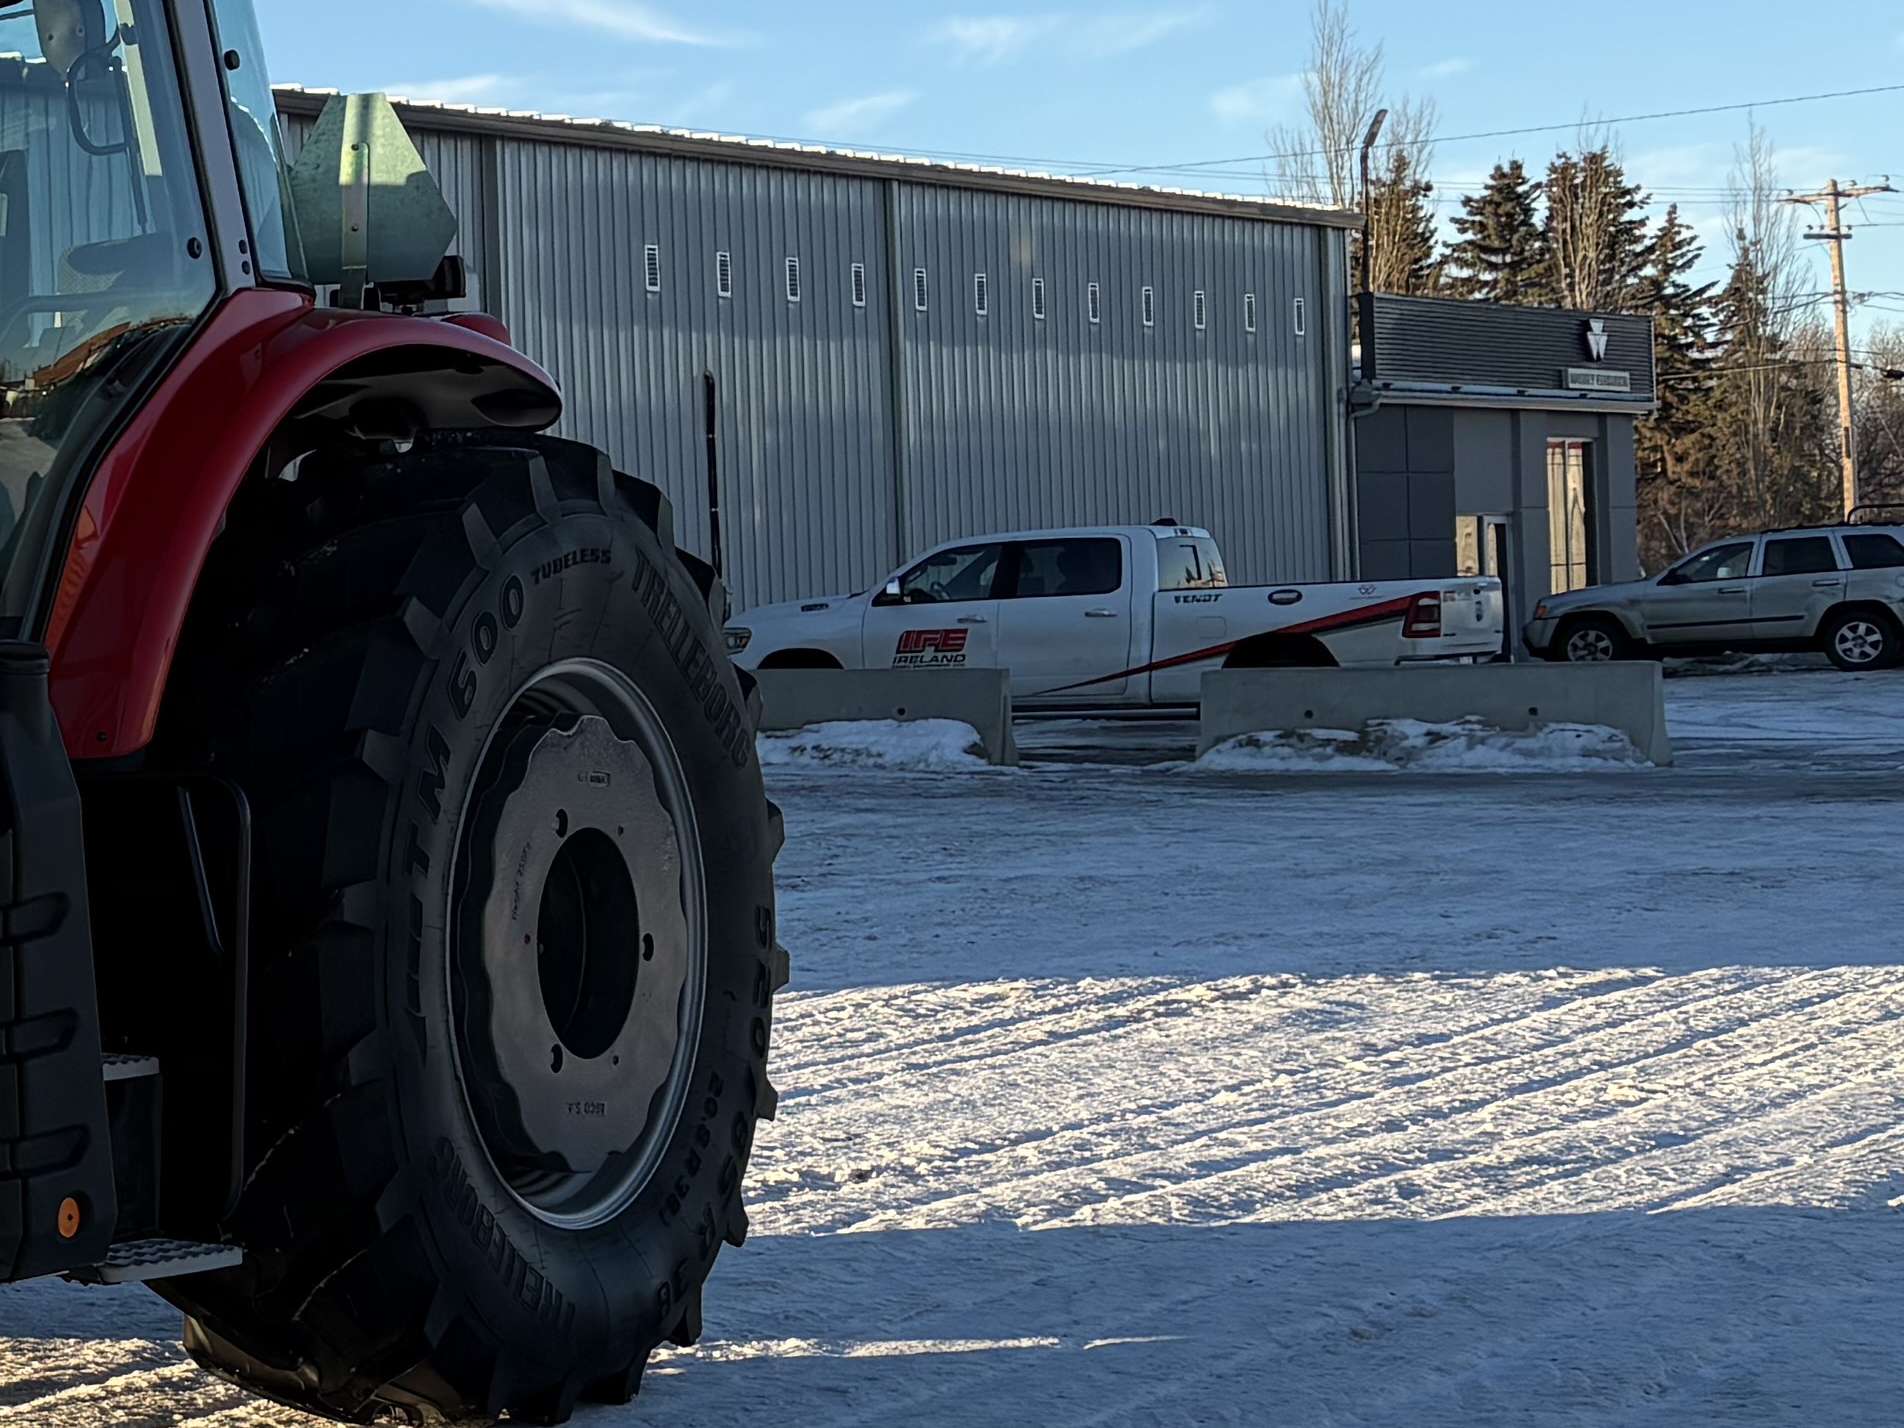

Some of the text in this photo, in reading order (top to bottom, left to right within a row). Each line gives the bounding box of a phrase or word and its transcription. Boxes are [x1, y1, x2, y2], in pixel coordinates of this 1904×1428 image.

[402, 574, 525, 877] TM 600
[632, 545, 750, 769] TRELLEBORG
[892, 654, 966, 664] IRELAND
[429, 1136, 577, 1342] TRELLEBORG
